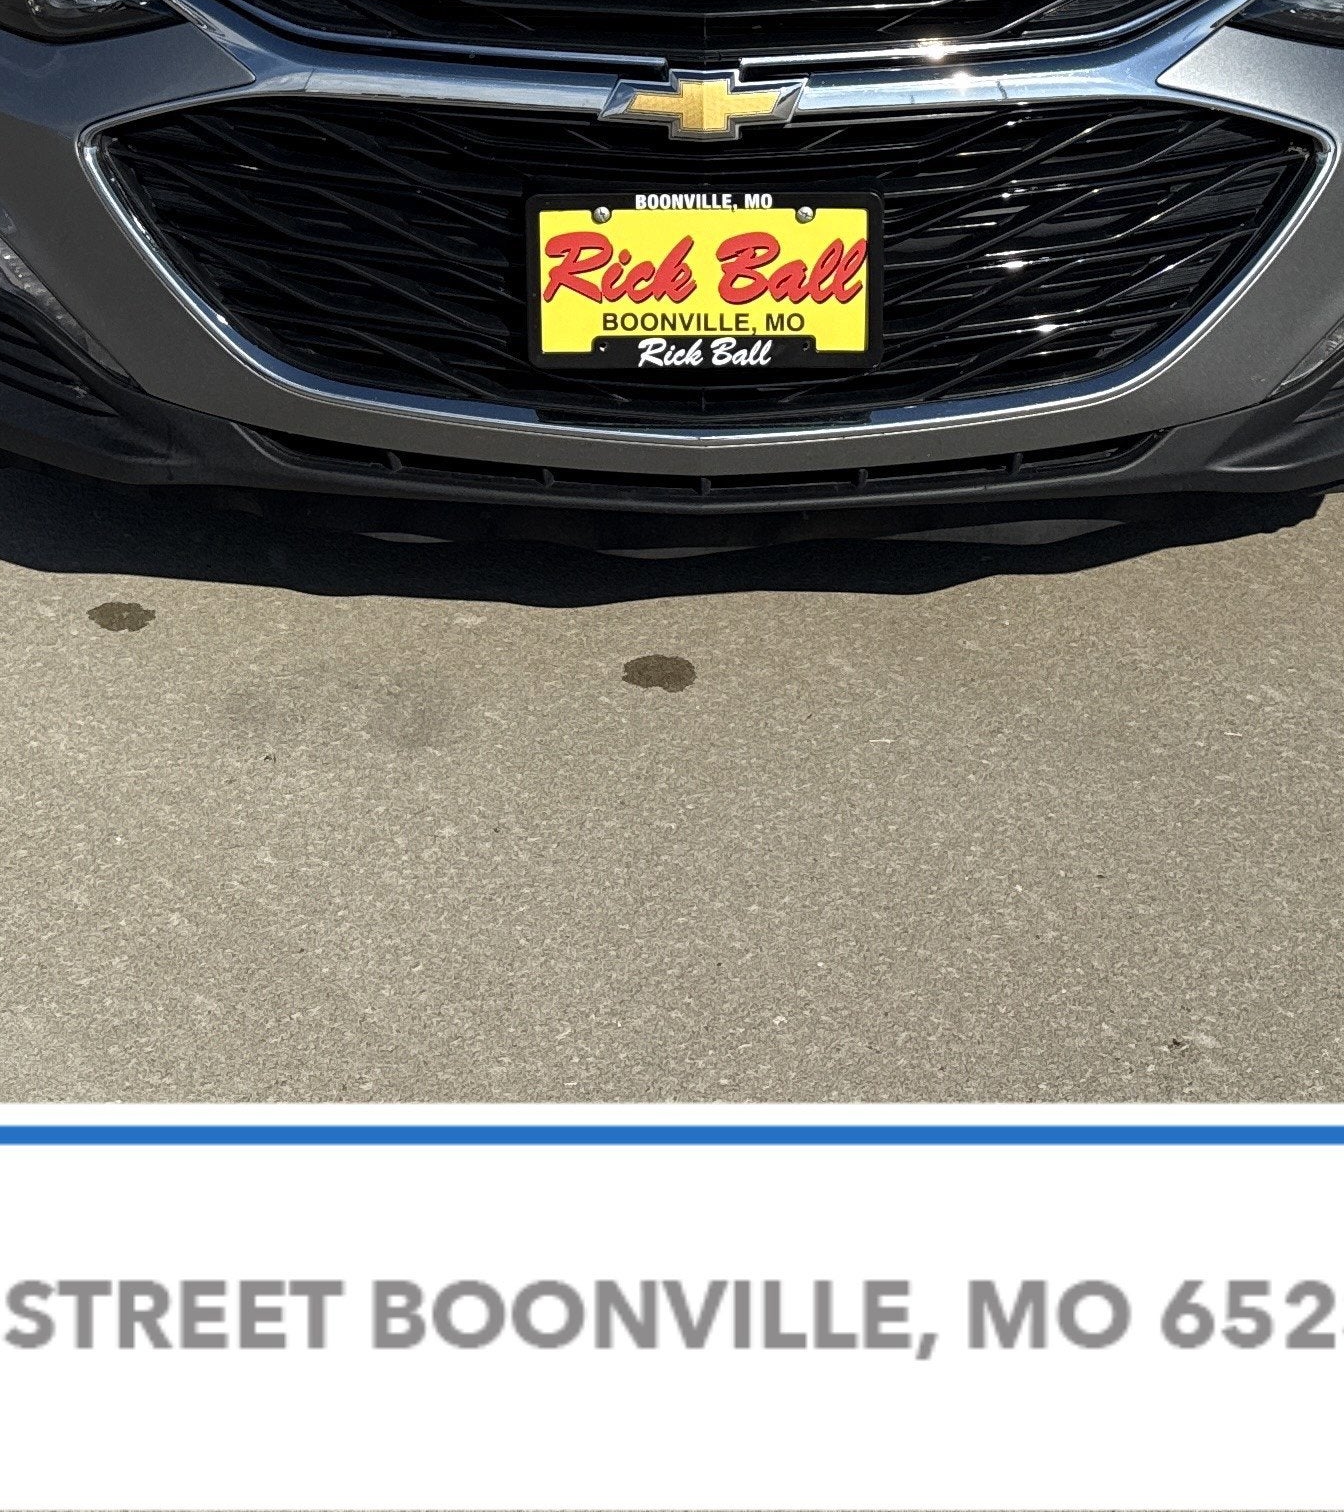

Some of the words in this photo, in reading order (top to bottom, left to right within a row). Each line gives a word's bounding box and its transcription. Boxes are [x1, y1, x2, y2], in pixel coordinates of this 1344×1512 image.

[634, 193, 738, 211] BOONVILLE,
[744, 193, 773, 209] MO
[543, 231, 697, 305] Rick
[715, 231, 868, 305] Ball
[602, 313, 758, 335] BOONVILLE,
[765, 313, 806, 332] MO
[638, 338, 705, 368] Rick
[710, 337, 773, 367] Ball
